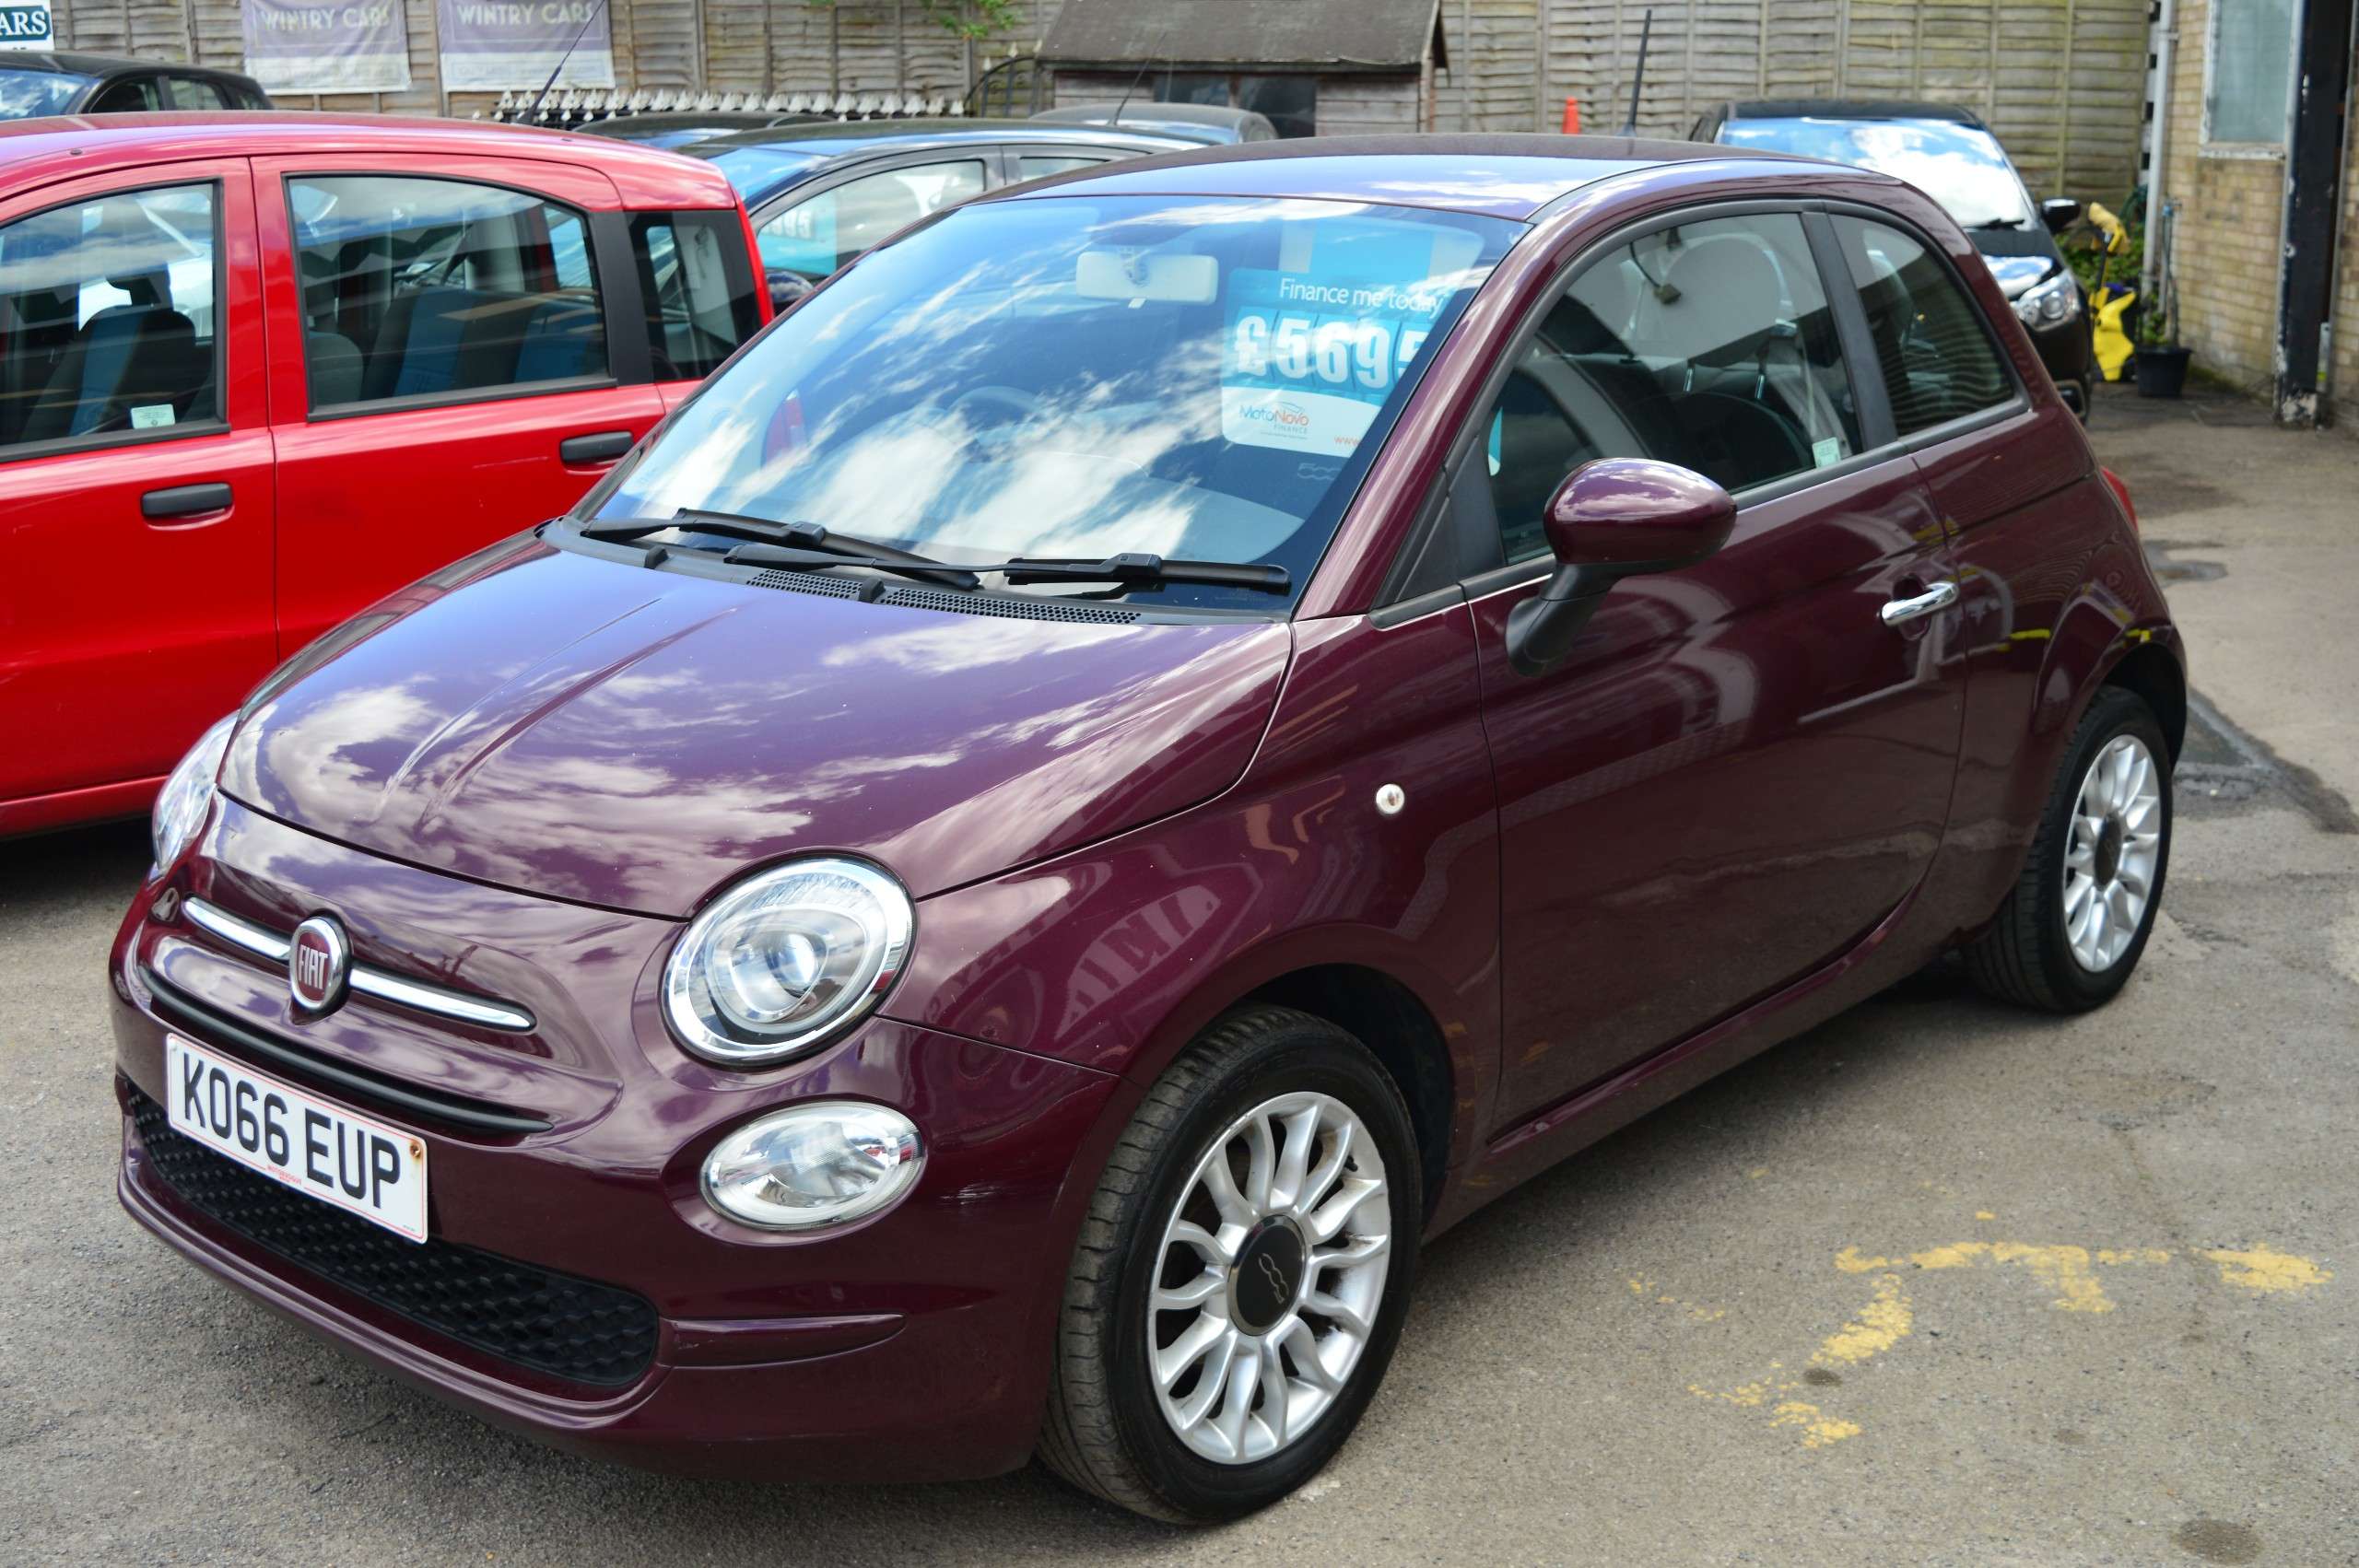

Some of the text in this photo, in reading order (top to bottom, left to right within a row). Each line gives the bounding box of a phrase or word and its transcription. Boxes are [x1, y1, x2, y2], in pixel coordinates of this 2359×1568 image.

[262, 8, 335, 30] WINTRY
[456, 3, 592, 26] WINTRY CARS
[1279, 277, 1444, 320] Finance me today
[1238, 404, 1309, 427] MotoNovo
[298, 943, 329, 990] FIAT
[304, 1107, 402, 1211] EUP
